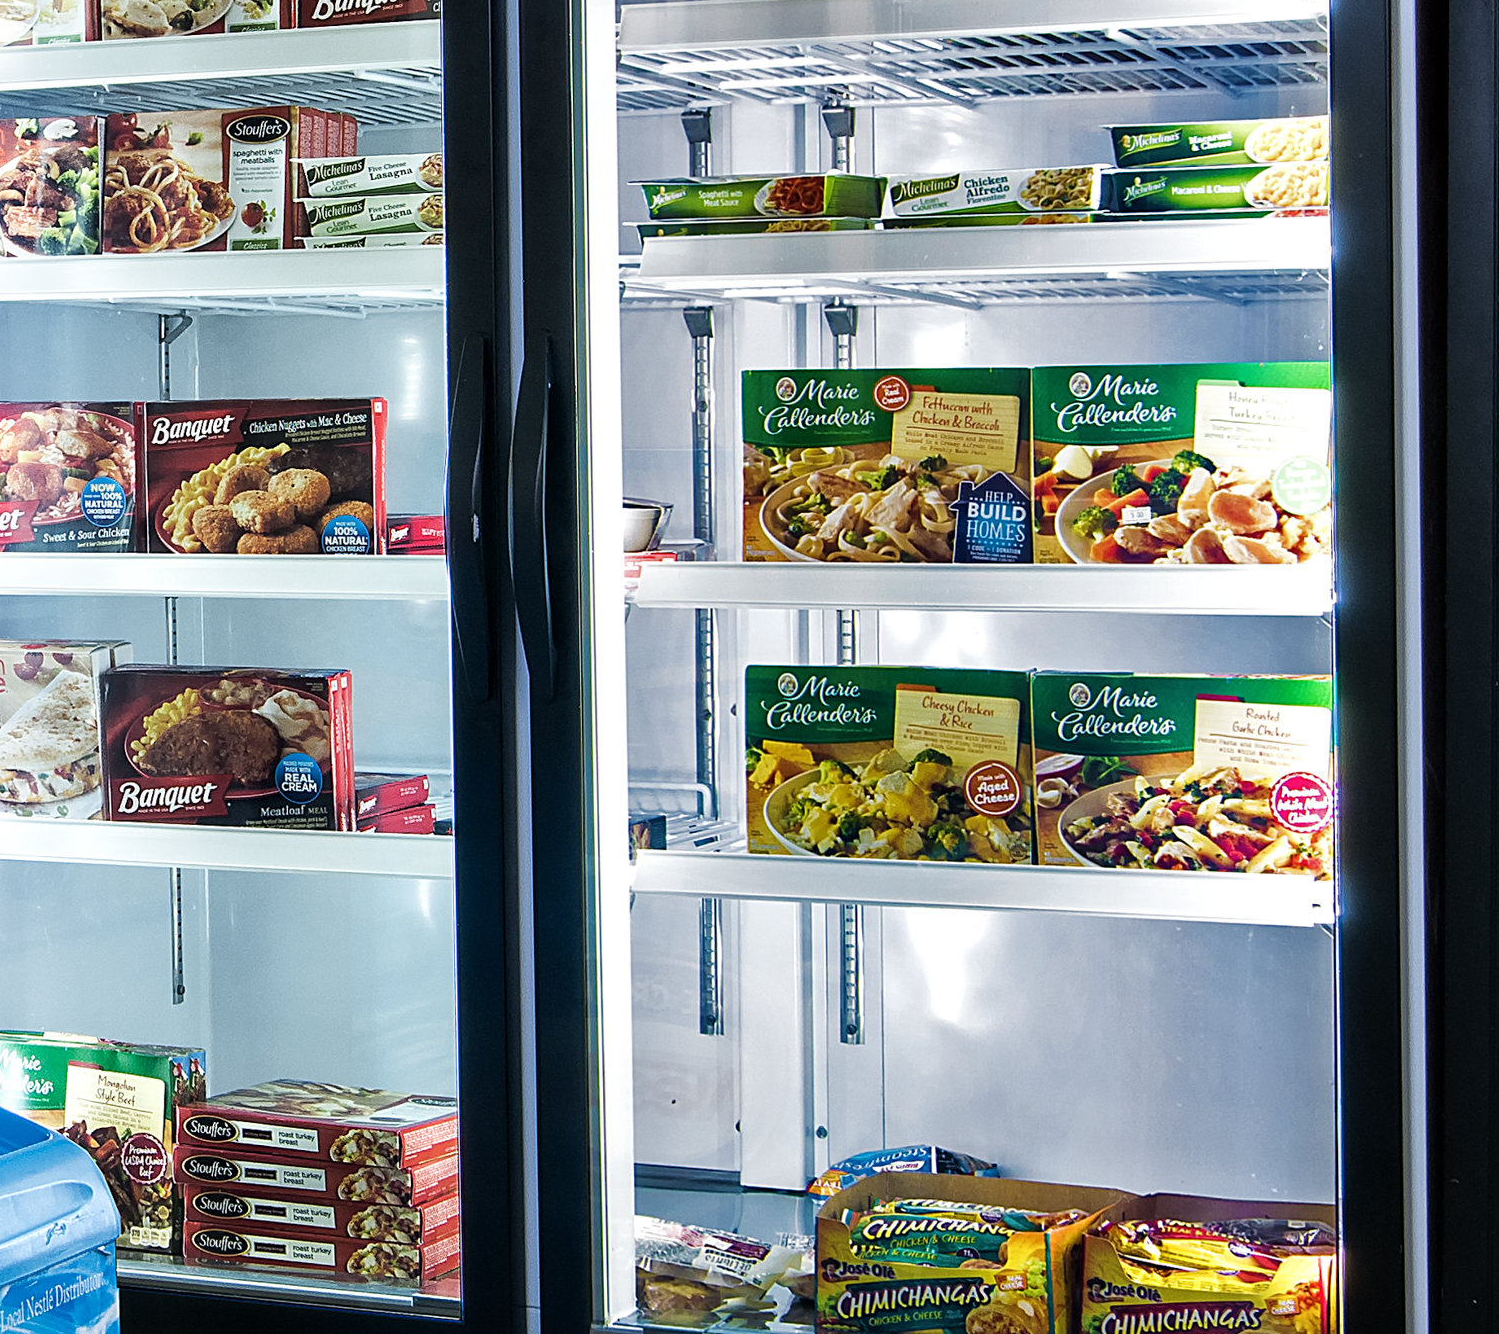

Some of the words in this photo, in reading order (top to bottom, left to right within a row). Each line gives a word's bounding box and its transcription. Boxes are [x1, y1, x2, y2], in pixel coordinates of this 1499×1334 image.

[235, 120, 282, 139] Stouffer's
[964, 175, 1008, 189] Chicken
[966, 183, 1010, 198] Alfredo
[151, 414, 235, 445] Banquet
[249, 422, 277, 434] Chicken
[278, 418, 306, 433] Nuggets
[318, 416, 333, 427] Mac
[342, 413, 368, 425] Cheese
[91, 484, 116, 492] NOW
[43, 533, 66, 543] Sweet
[69, 532, 76, 540] &
[78, 530, 96, 540] Sour
[98, 527, 130, 539] Chicken
[333, 526, 358, 536] 100%
[325, 536, 367, 546] NATURAL
[284, 773, 314, 783] REAL
[282, 781, 318, 793] CREAM
[977, 781, 1009, 794] Aged
[118, 781, 217, 813] Banquet
[974, 793, 1015, 805] Cheese
[260, 804, 304, 817] Meatloaf
[308, 806, 328, 815] MEAL
[98, 1075, 136, 1092] Mongolian
[837, 1284, 991, 1319] CHIMICHANGAS
[0, 1307, 25, 1332] Local
[26, 1288, 53, 1322] Nestlé
